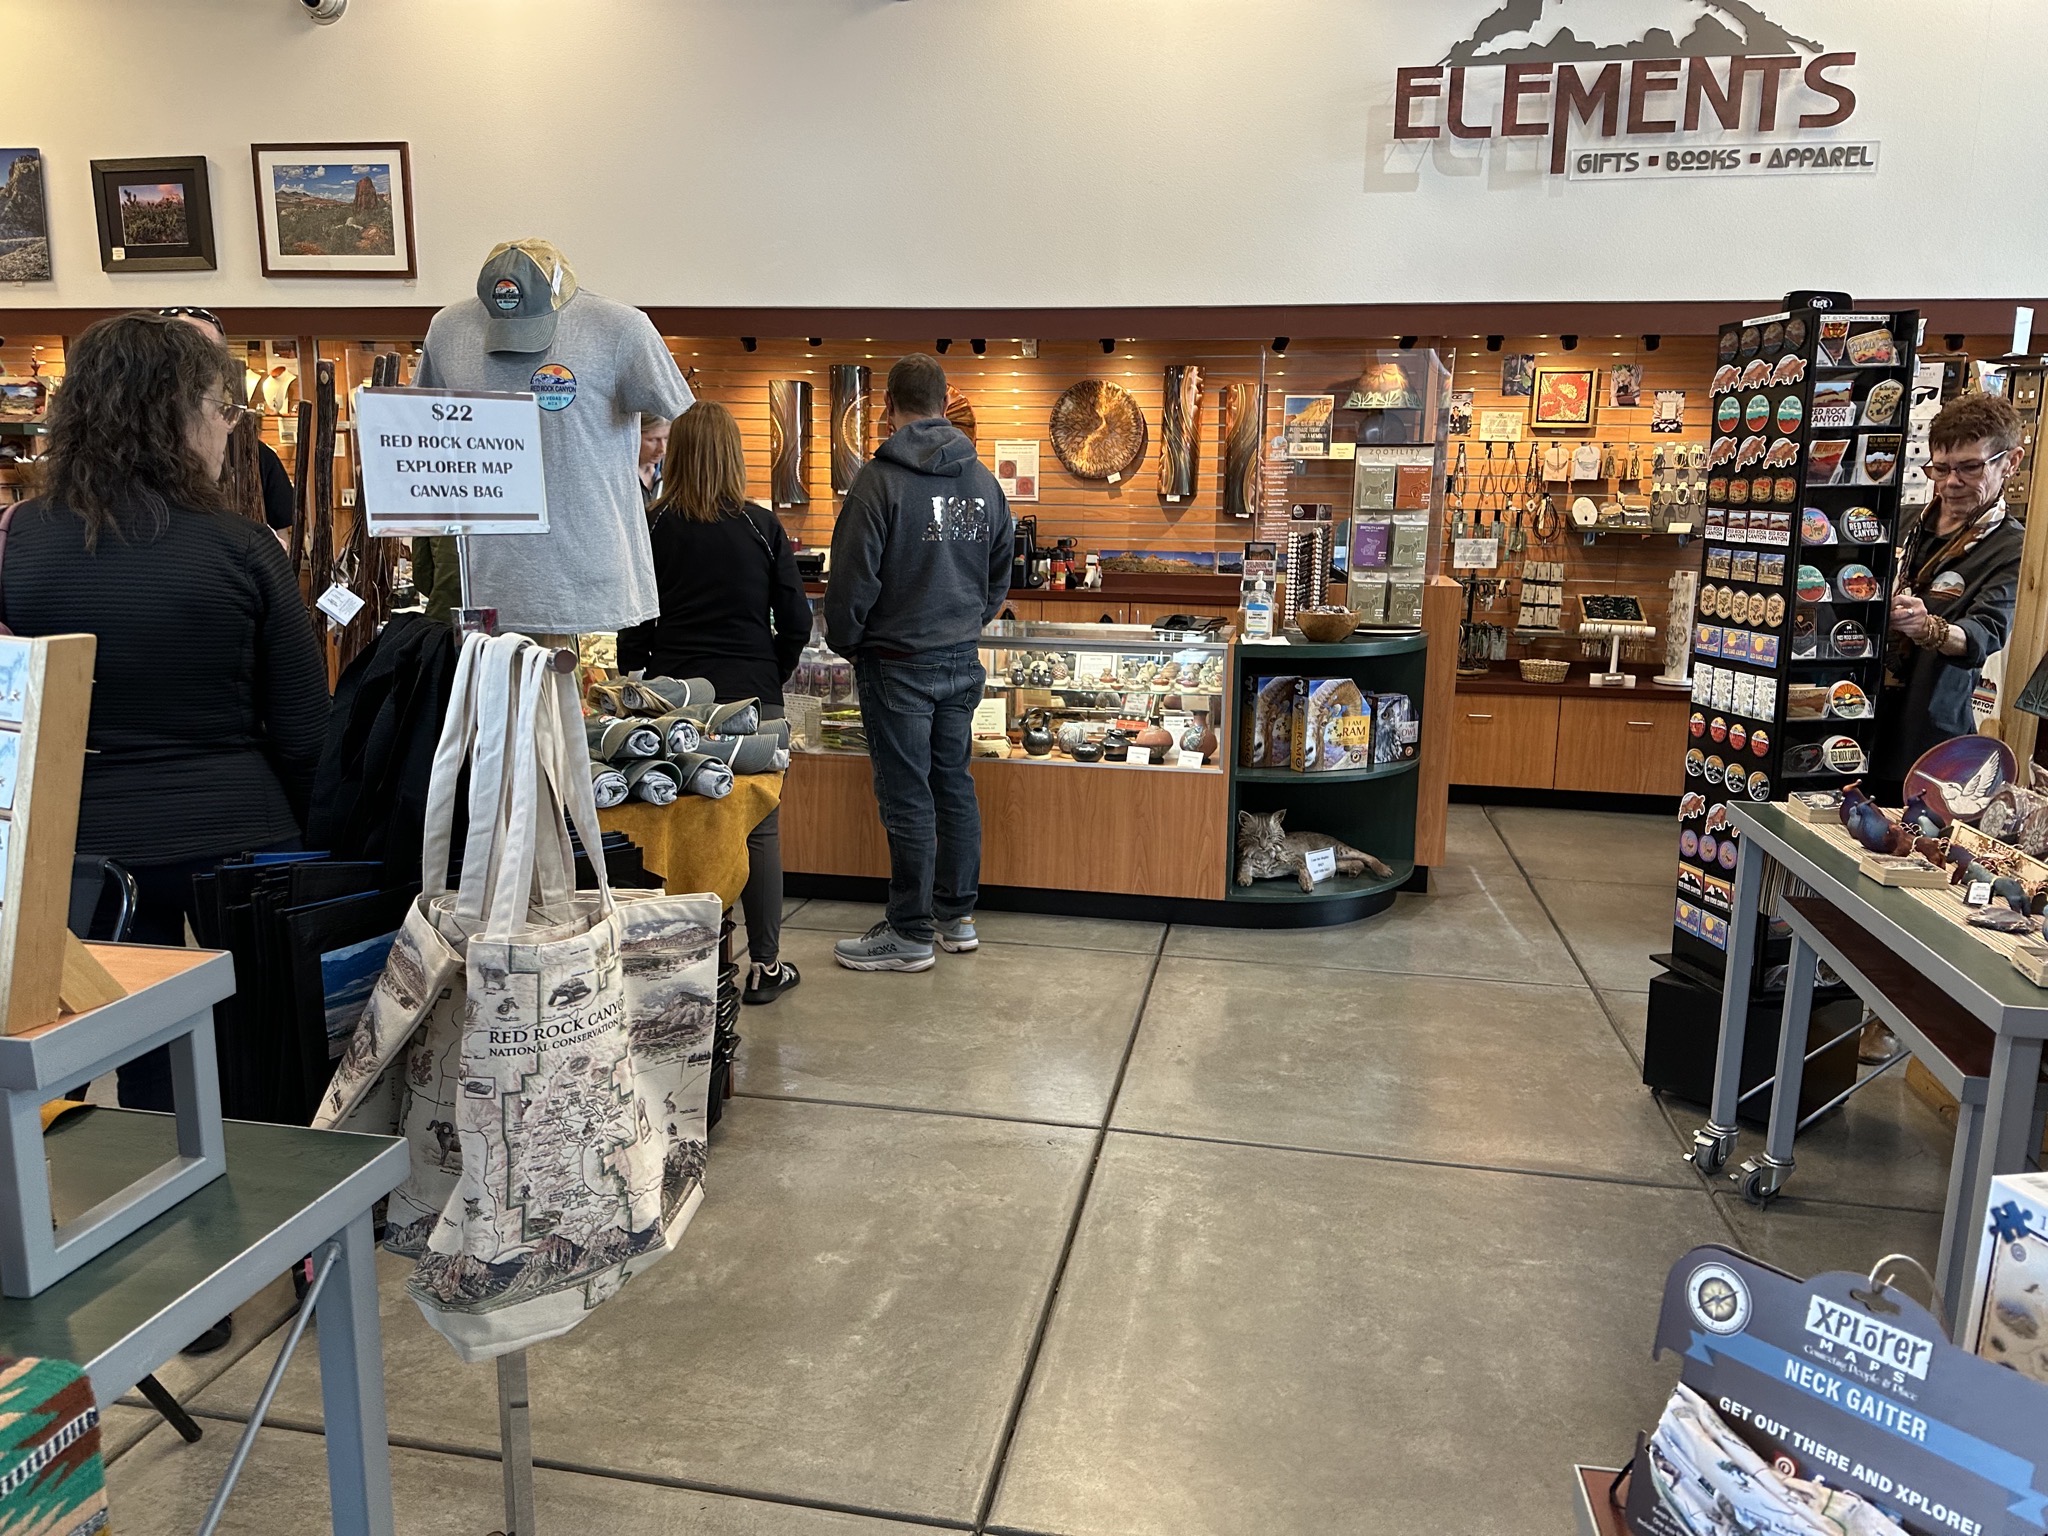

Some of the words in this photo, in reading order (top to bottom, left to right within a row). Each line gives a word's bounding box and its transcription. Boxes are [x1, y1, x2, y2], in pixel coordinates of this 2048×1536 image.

[1393, 51, 1856, 175] ELEMENTS
[1576, 152, 1640, 174] GIFTS
[1666, 149, 1741, 171] BOOKS
[1767, 146, 1874, 169] APPAREL
[1812, 299, 1828, 310] tgt
[555, 385, 577, 393] CANYON
[431, 403, 474, 421] $22
[1811, 415, 1846, 423] ANYON
[1825, 408, 1848, 416] ROCK
[380, 434, 413, 448] RED
[418, 435, 462, 450] ROCK
[466, 437, 525, 451] CANYON
[1369, 448, 1422, 456] ZOOTILITY
[396, 460, 477, 474] EXPLORER
[482, 462, 513, 474] MAP
[410, 484, 468, 498] CANVAS
[473, 485, 504, 499] BAG
[1849, 521, 1862, 531] RED
[1863, 521, 1879, 530] ROCK
[1853, 528, 1879, 538] CANYON
[1342, 726, 1366, 737] RAM
[1401, 728, 1416, 737] OWL
[1830, 750, 1838, 762] RED
[1838, 750, 1849, 762] ROCK
[1850, 750, 1861, 762] CANYON
[489, 1030, 528, 1044] RED
[533, 1017, 585, 1041] ROCK
[588, 998, 626, 1026] CANYO
[489, 1043, 550, 1057] NATIONAL
[552, 1018, 619, 1049] CONSERVATION
[1819, 1338, 1906, 1384] MAPS
[1784, 1359, 1842, 1402] NECK
[1846, 1387, 1928, 1442] GAITER
[1719, 1396, 1752, 1424] GET
[1754, 1414, 1790, 1441] OUT
[1793, 1431, 1850, 1472] THERE
[1851, 1463, 1893, 1494] AND
[1895, 1483, 1985, 1536] XPLORE!
